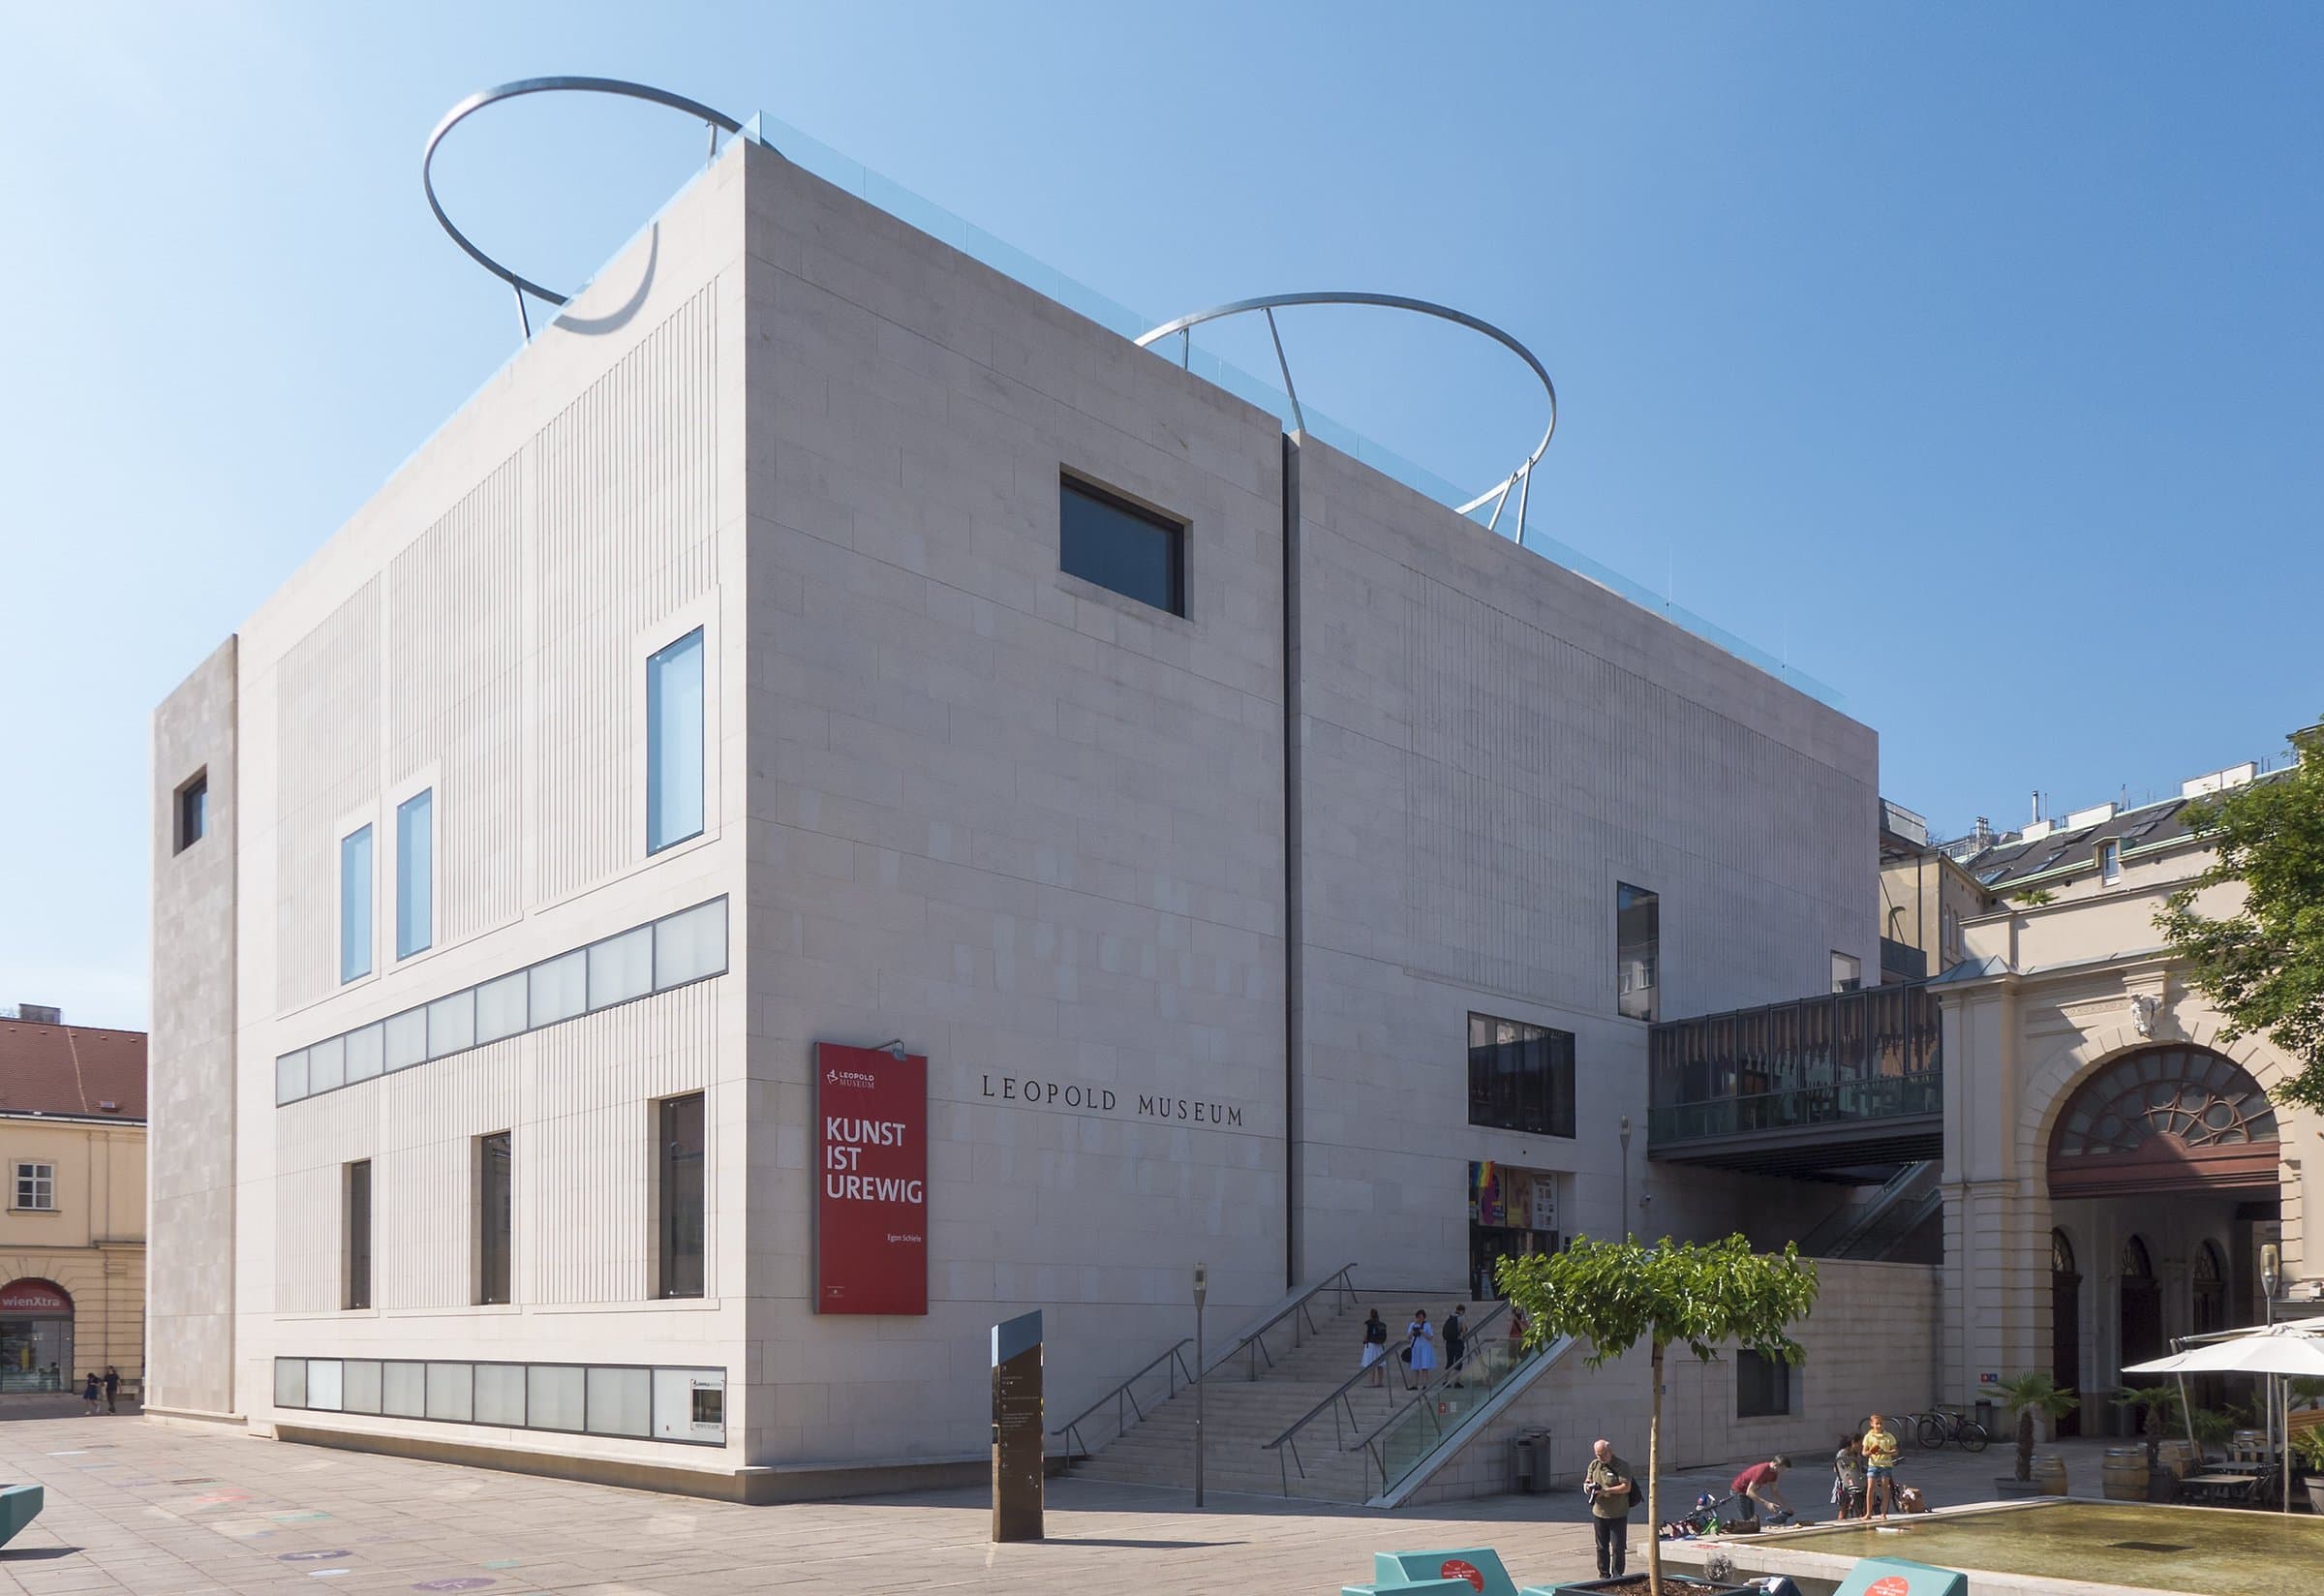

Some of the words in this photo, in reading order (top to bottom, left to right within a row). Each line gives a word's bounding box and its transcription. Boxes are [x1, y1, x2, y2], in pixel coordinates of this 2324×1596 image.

[840, 1071, 874, 1082] LEOPOLD
[840, 1079, 874, 1090] MUSEUM
[982, 1075, 1116, 1111] LEOPOLD
[1138, 1094, 1243, 1126] MUSEUM
[826, 1116, 906, 1148] KUNST
[827, 1145, 862, 1171] IST
[826, 1174, 923, 1204] UREWIG
[887, 1233, 902, 1243] Egon
[2, 1296, 60, 1306] wienXtra
